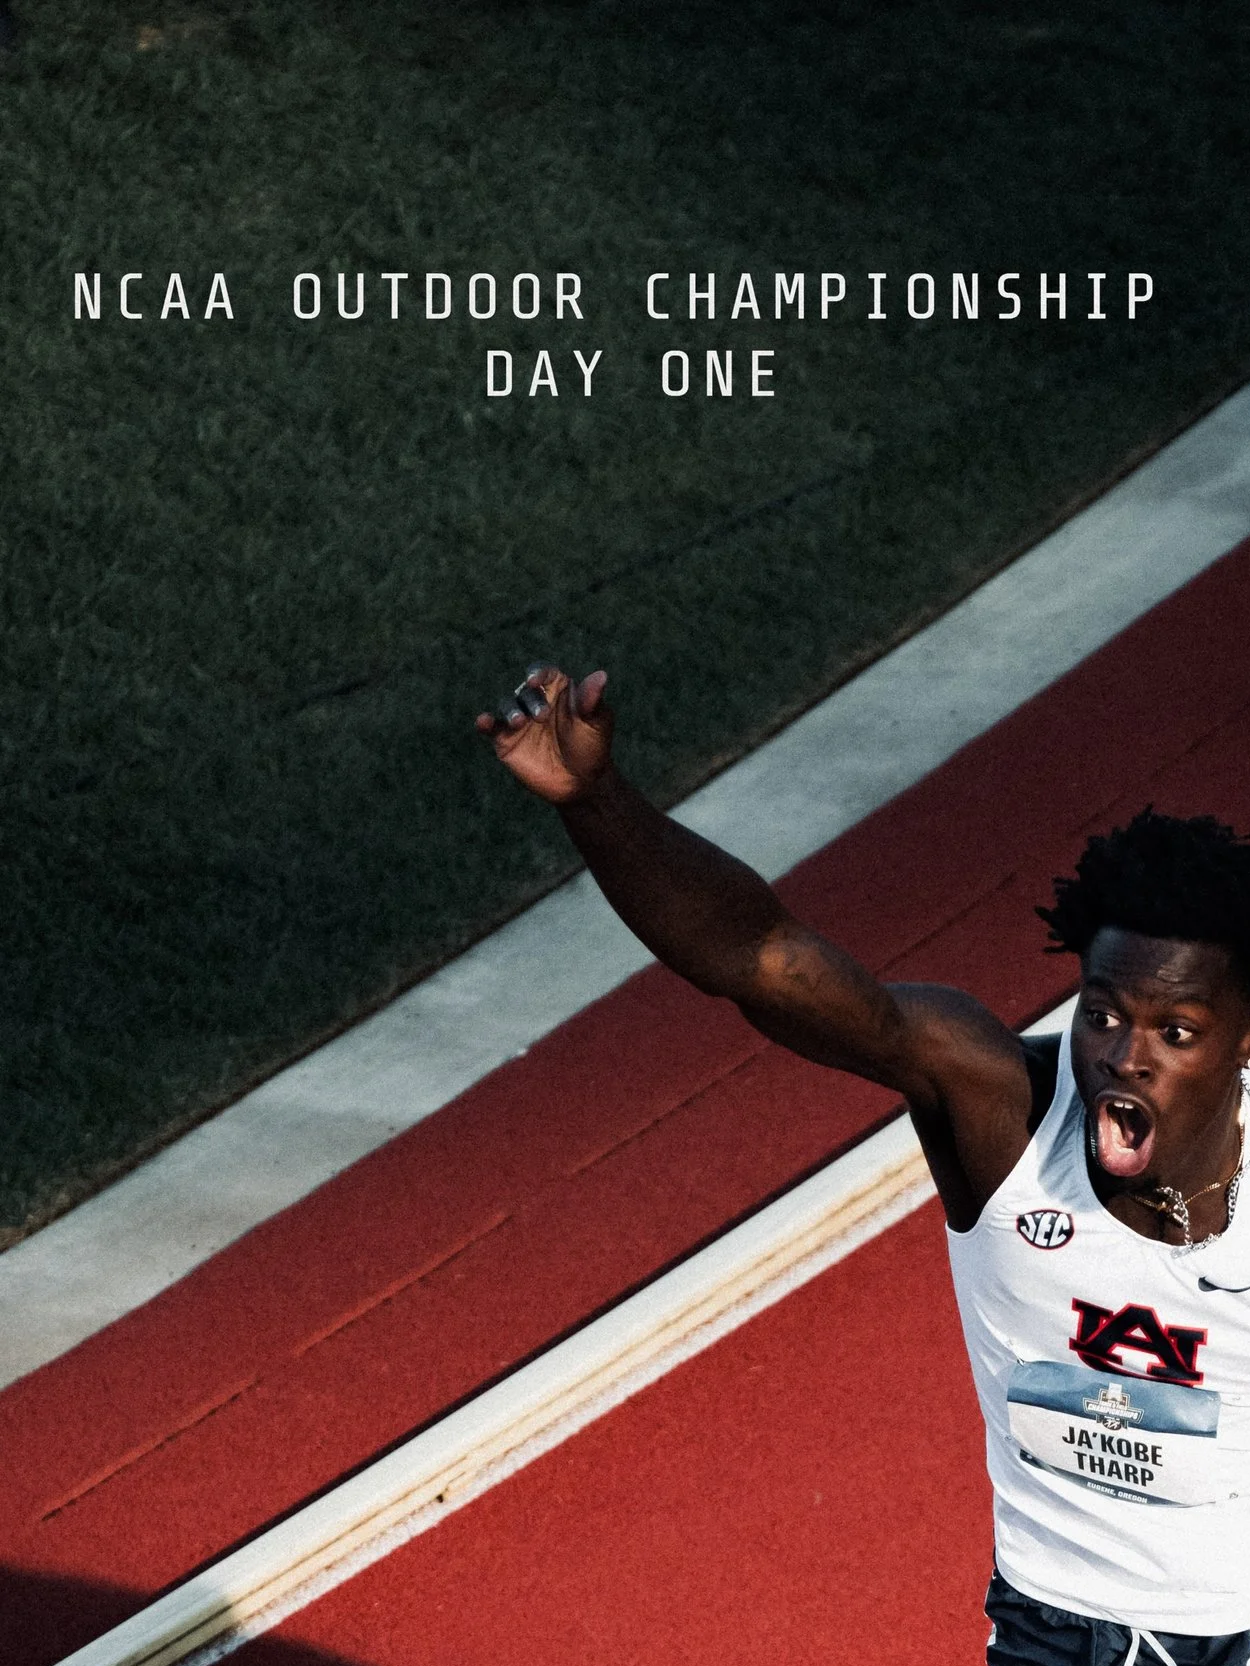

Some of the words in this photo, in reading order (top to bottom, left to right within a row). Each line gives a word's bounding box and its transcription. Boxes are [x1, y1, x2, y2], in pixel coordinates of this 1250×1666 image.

[1019, 1211, 1071, 1247] SEC
[1062, 1426, 1163, 1467] JA'KOBE
[1073, 1450, 1155, 1487] THARP
[1117, 1489, 1148, 1505] OREGON
